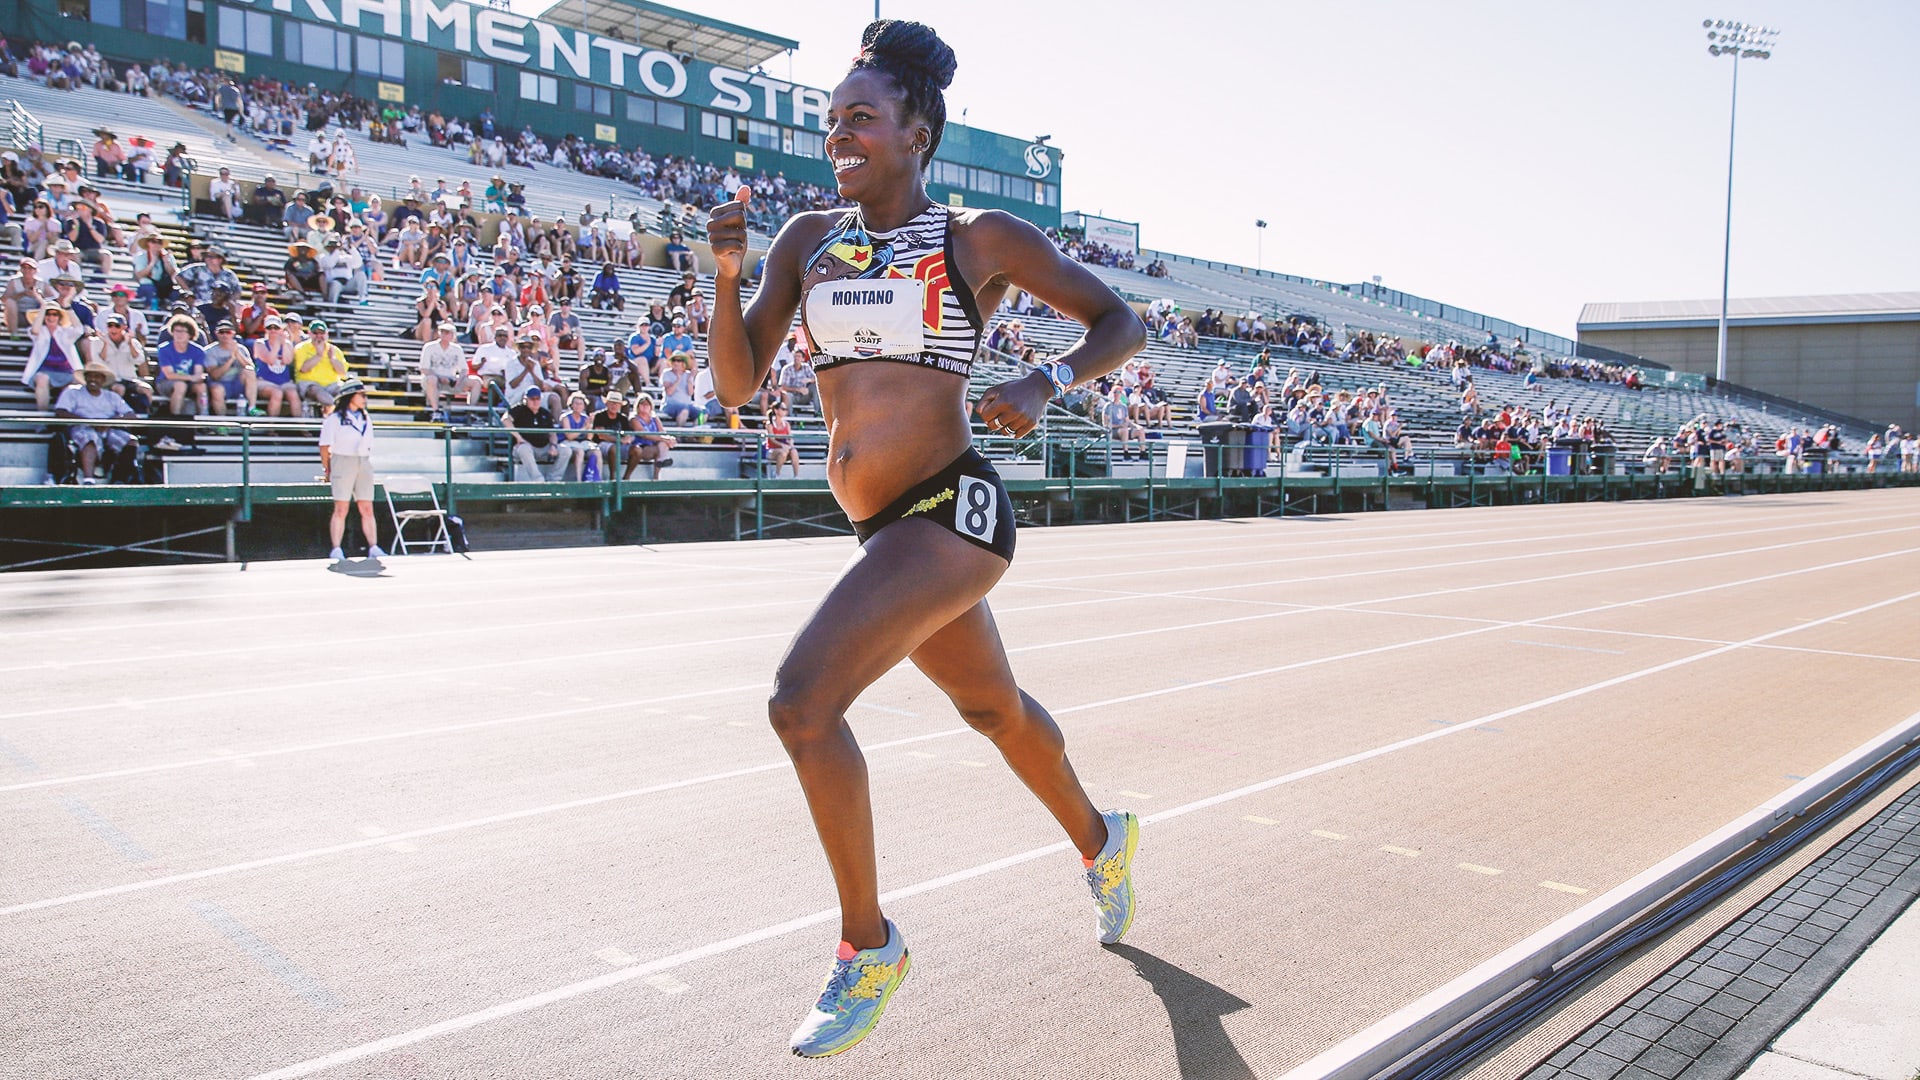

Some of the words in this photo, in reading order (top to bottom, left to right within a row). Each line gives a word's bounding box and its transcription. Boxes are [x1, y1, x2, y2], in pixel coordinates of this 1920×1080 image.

[832, 289, 894, 306] MONTANO
[854, 336, 882, 345] USATF
[965, 481, 991, 536] 8
